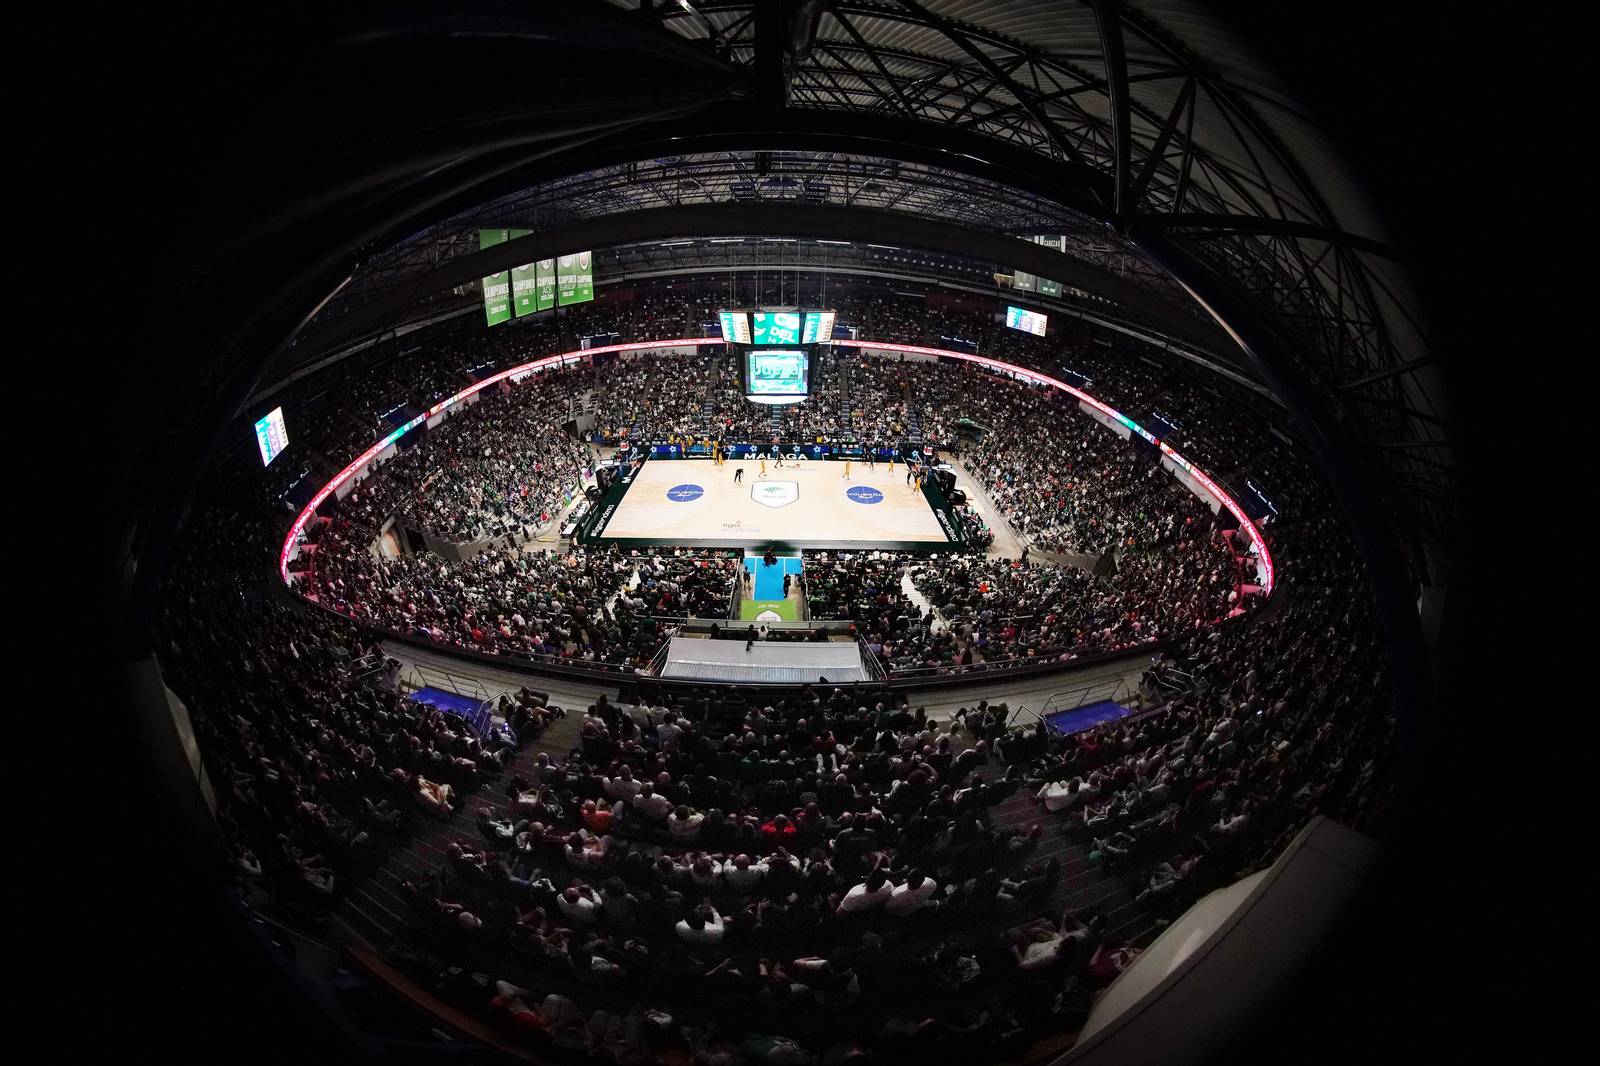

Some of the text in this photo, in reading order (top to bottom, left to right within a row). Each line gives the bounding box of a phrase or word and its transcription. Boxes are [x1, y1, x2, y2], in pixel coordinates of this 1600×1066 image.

[558, 275, 576, 284] CAMPEONES
[513, 279, 535, 291] CAMPEONES
[543, 285, 552, 294] ACB
[560, 283, 577, 291] EUROCUP
[485, 283, 509, 298] CAMPEONES
[770, 326, 795, 343] DEL
[743, 452, 808, 460] MÁLAGA
